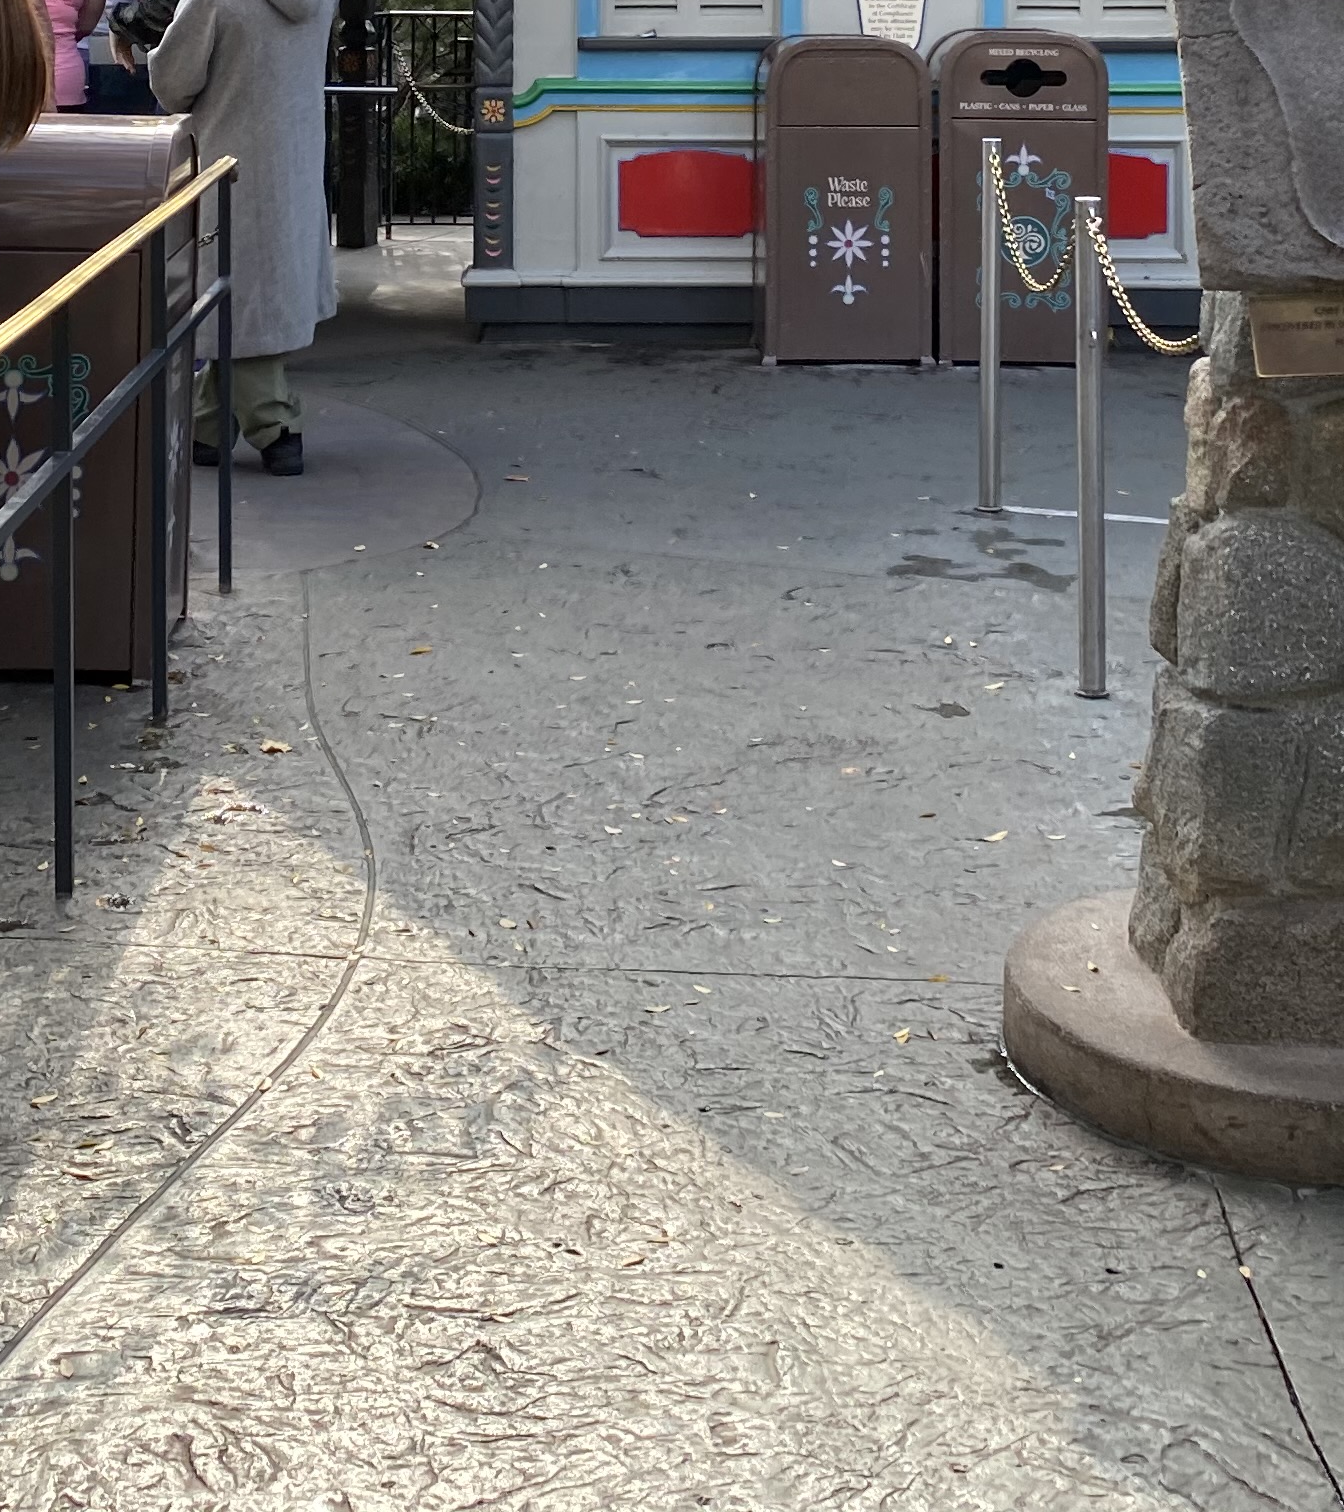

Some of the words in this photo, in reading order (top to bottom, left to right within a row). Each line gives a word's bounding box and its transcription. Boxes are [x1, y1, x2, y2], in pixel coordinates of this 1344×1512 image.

[989, 48, 1014, 56] MIXED
[1015, 48, 1060, 57] RECYCLING
[959, 102, 992, 110] PLASTIC
[998, 103, 1020, 111] CANS
[1062, 104, 1088, 112] GLASS
[827, 176, 868, 192] Waste
[827, 192, 871, 208] Please
